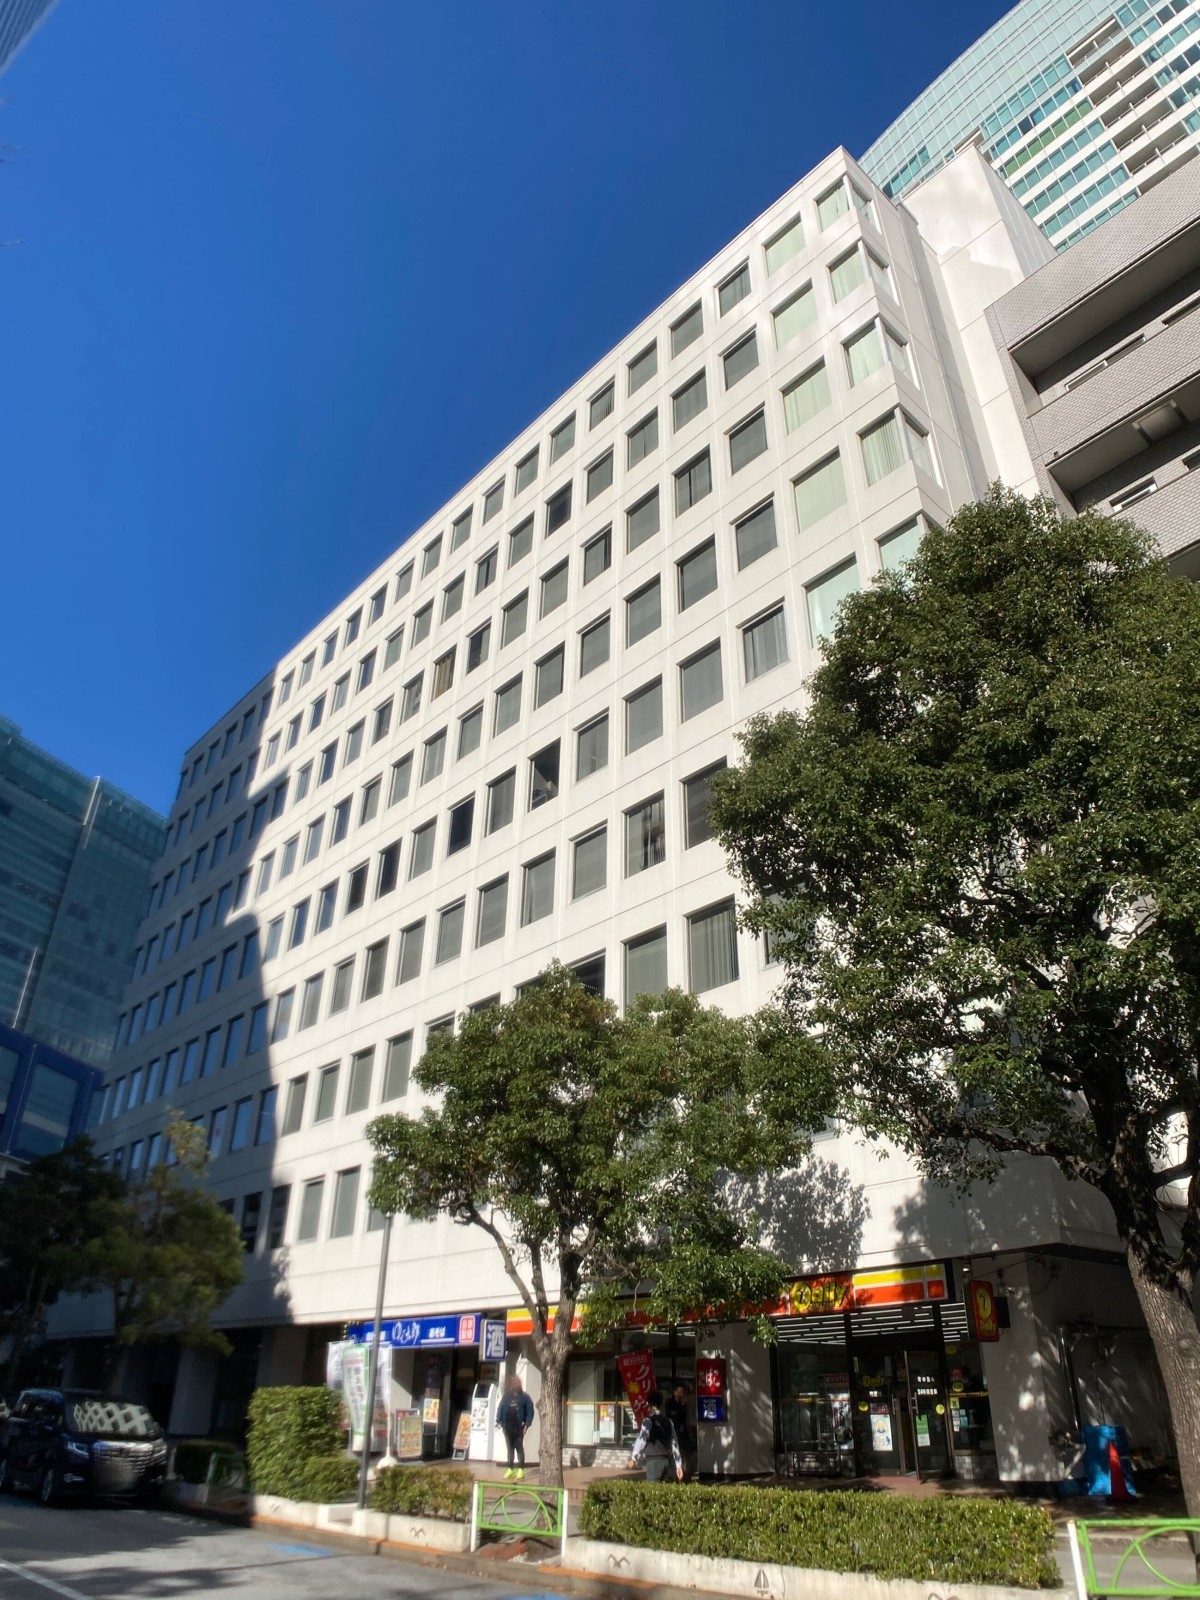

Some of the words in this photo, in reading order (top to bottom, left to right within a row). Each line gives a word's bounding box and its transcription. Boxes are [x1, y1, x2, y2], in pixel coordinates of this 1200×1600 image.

[790, 1281, 848, 1311] Daily
[487, 1323, 505, 1357] 酒
[703, 1398, 717, 1419] 酒
